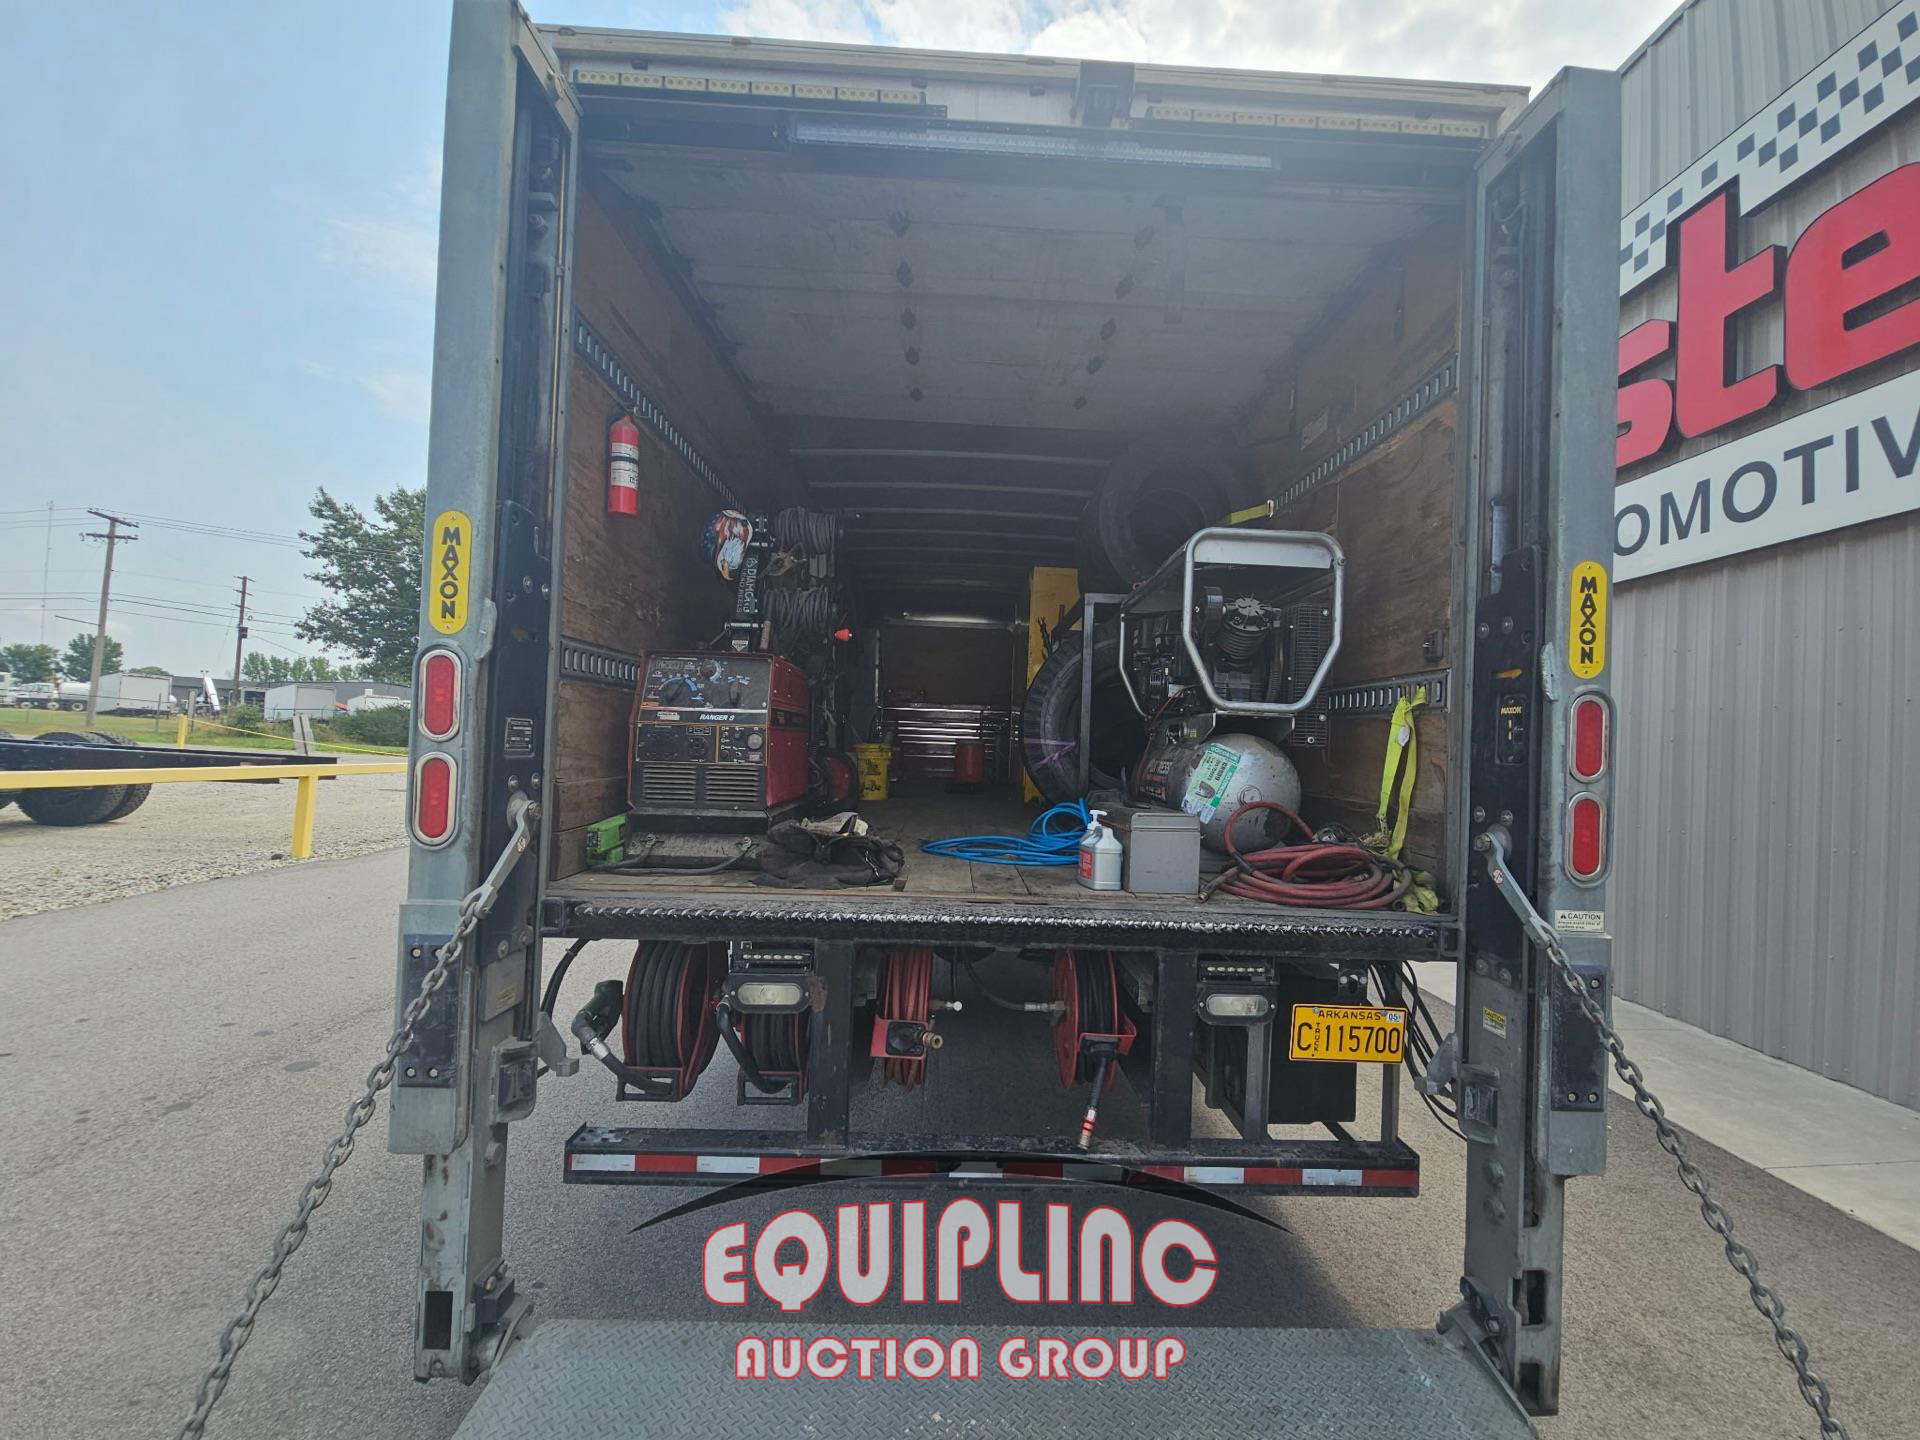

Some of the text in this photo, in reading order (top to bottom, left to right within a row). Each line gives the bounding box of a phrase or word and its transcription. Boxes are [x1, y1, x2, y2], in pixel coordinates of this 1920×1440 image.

[440, 526, 461, 619] MAXON
[1579, 576, 1598, 664] MAXON
[1567, 912, 1601, 921] CAUTION
[1318, 1009, 1381, 1021] ARKANSAS
[1324, 1024, 1400, 1054] 115700
